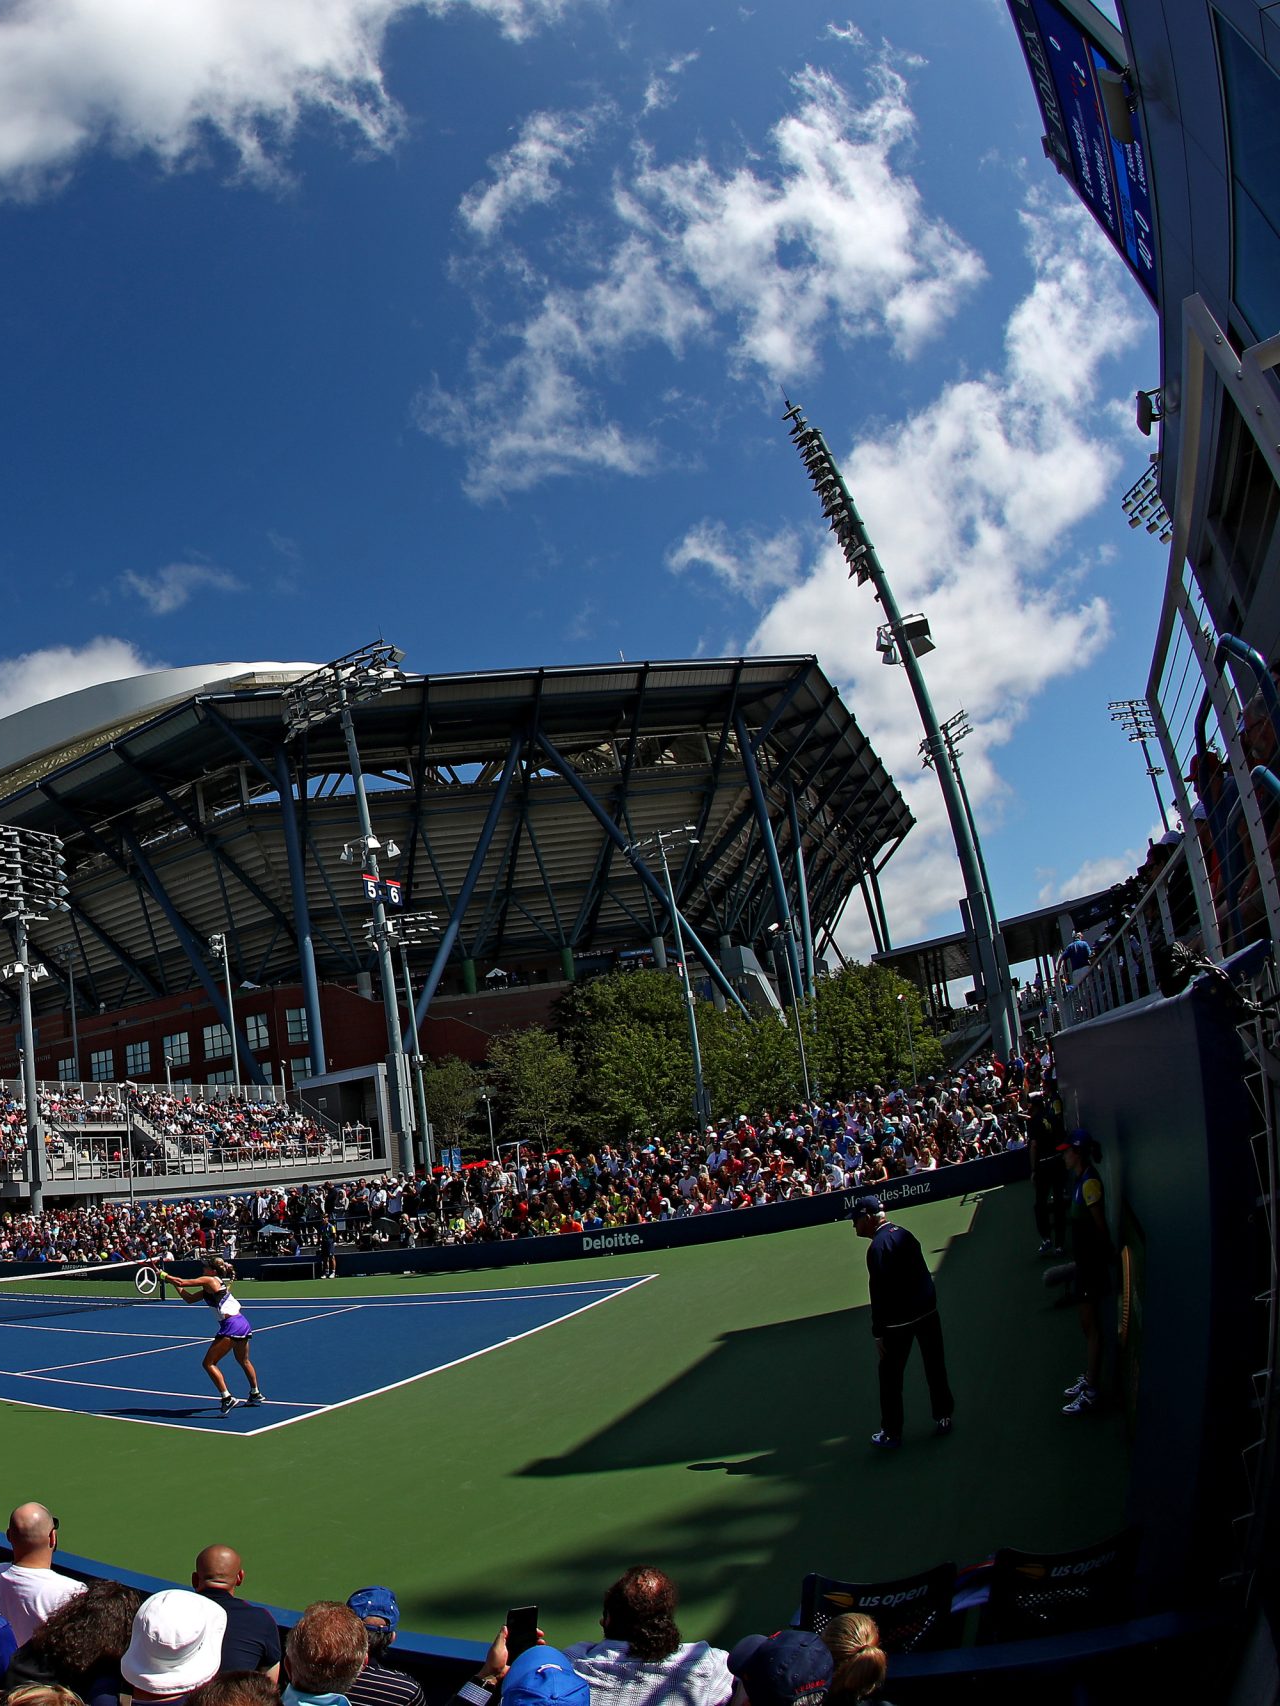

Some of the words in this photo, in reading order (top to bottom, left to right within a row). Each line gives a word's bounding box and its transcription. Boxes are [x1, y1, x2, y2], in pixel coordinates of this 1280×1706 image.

[1020, 18, 1061, 130] ROLEX
[367, 881, 377, 898] 5
[390, 886, 399, 903] 6
[843, 1181, 931, 1210] Meedes-Benz
[582, 1232, 644, 1251] Deloitte.
[1069, 1550, 1118, 1577] open
[858, 1593, 882, 1608] us
[882, 1583, 930, 1607] open
